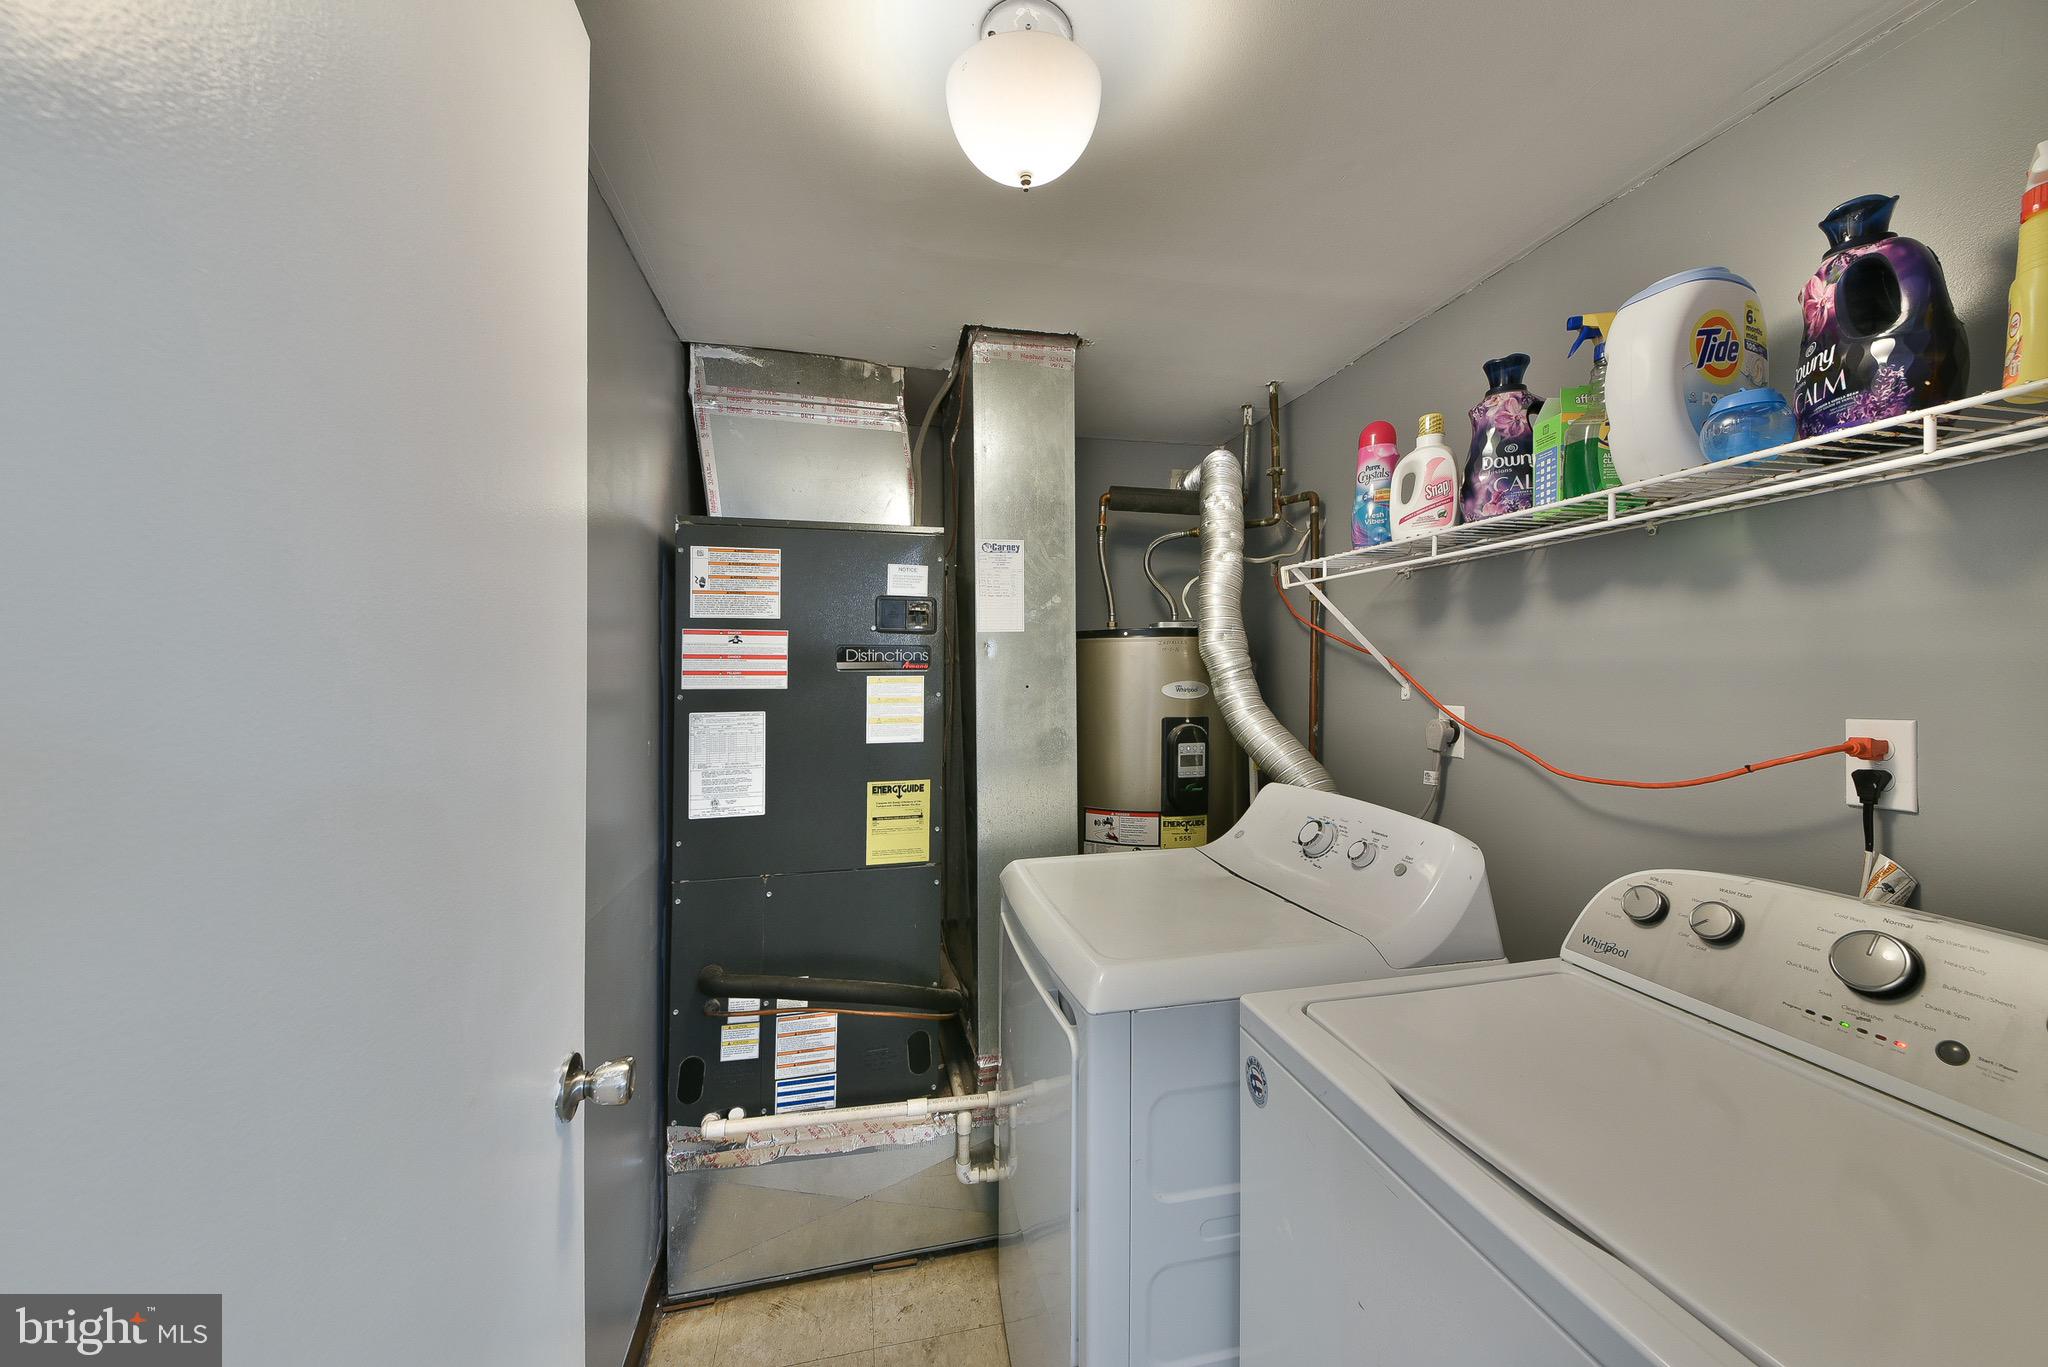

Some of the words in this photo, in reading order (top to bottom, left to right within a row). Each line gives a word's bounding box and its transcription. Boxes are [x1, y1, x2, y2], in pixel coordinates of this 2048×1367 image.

[1696, 328, 1740, 370] Tide
[1796, 344, 1836, 383] owny
[1796, 369, 1846, 414] CALM
[1358, 468, 1390, 485] Crystals
[1494, 474, 1534, 492] CAL
[1425, 480, 1450, 500] Snap
[992, 543, 1020, 553] Carney
[846, 649, 929, 662] Distinctions
[872, 784, 924, 796] ENERGYGUIDE
[1882, 918, 1914, 929] Normal
[1582, 934, 1629, 958] Whirlpool
[1797, 941, 1821, 952] Delicate
[1786, 960, 1802, 968] Quick
[1804, 965, 1819, 974] Wash
[1841, 1004, 1859, 1013] Clean
[1953, 1012, 1971, 1021] Spin
[1920, 1023, 1936, 1032] Spin
